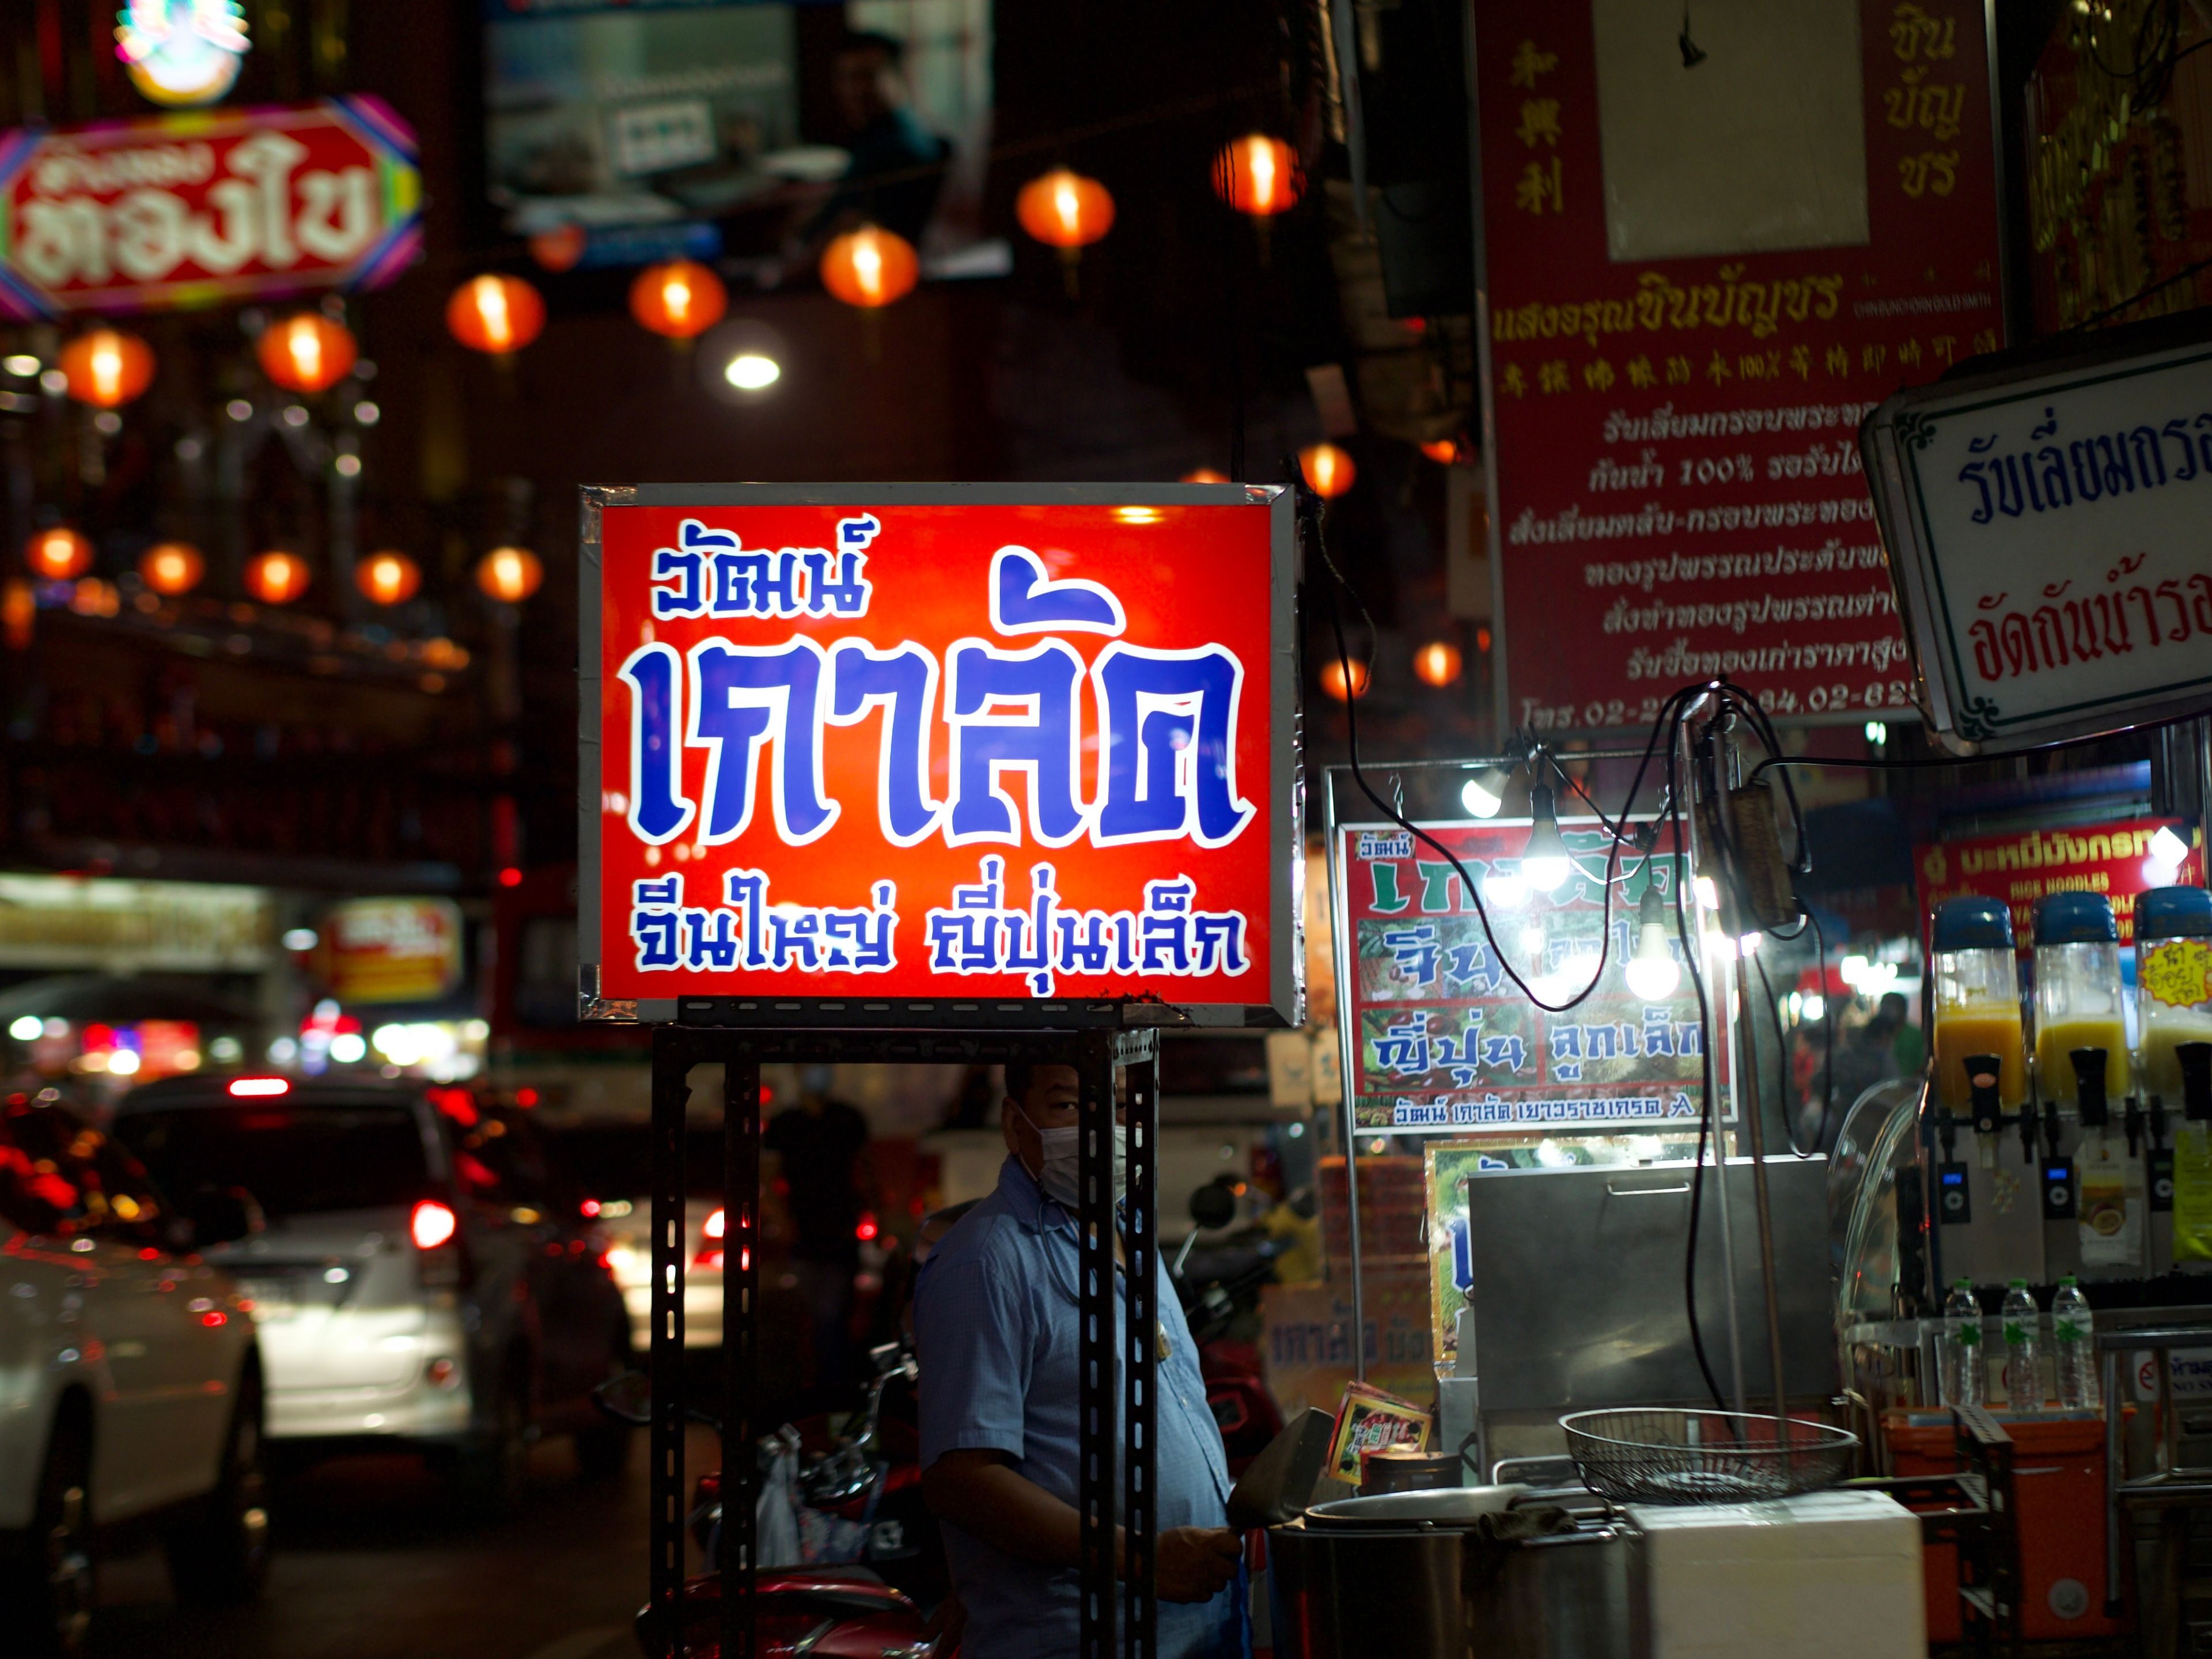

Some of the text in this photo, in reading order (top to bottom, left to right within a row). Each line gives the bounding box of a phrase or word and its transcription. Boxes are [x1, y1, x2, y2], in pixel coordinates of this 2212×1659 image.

[1680, 453, 1755, 487] 100%
[652, 513, 880, 620] วัฒน์
[618, 545, 1257, 848] เกาลัด
[1360, 832, 1412, 859] วัฒน์
[630, 855, 1249, 998] จีนใหญ่ ญี่ปุ่นเล็ก
[1372, 1007, 1528, 1089] ญี่ปุ่น
[1395, 1093, 1448, 1126] วัฒน์
[1452, 1093, 1513, 1123] เกาลัด
[1667, 1093, 1695, 1118] A
